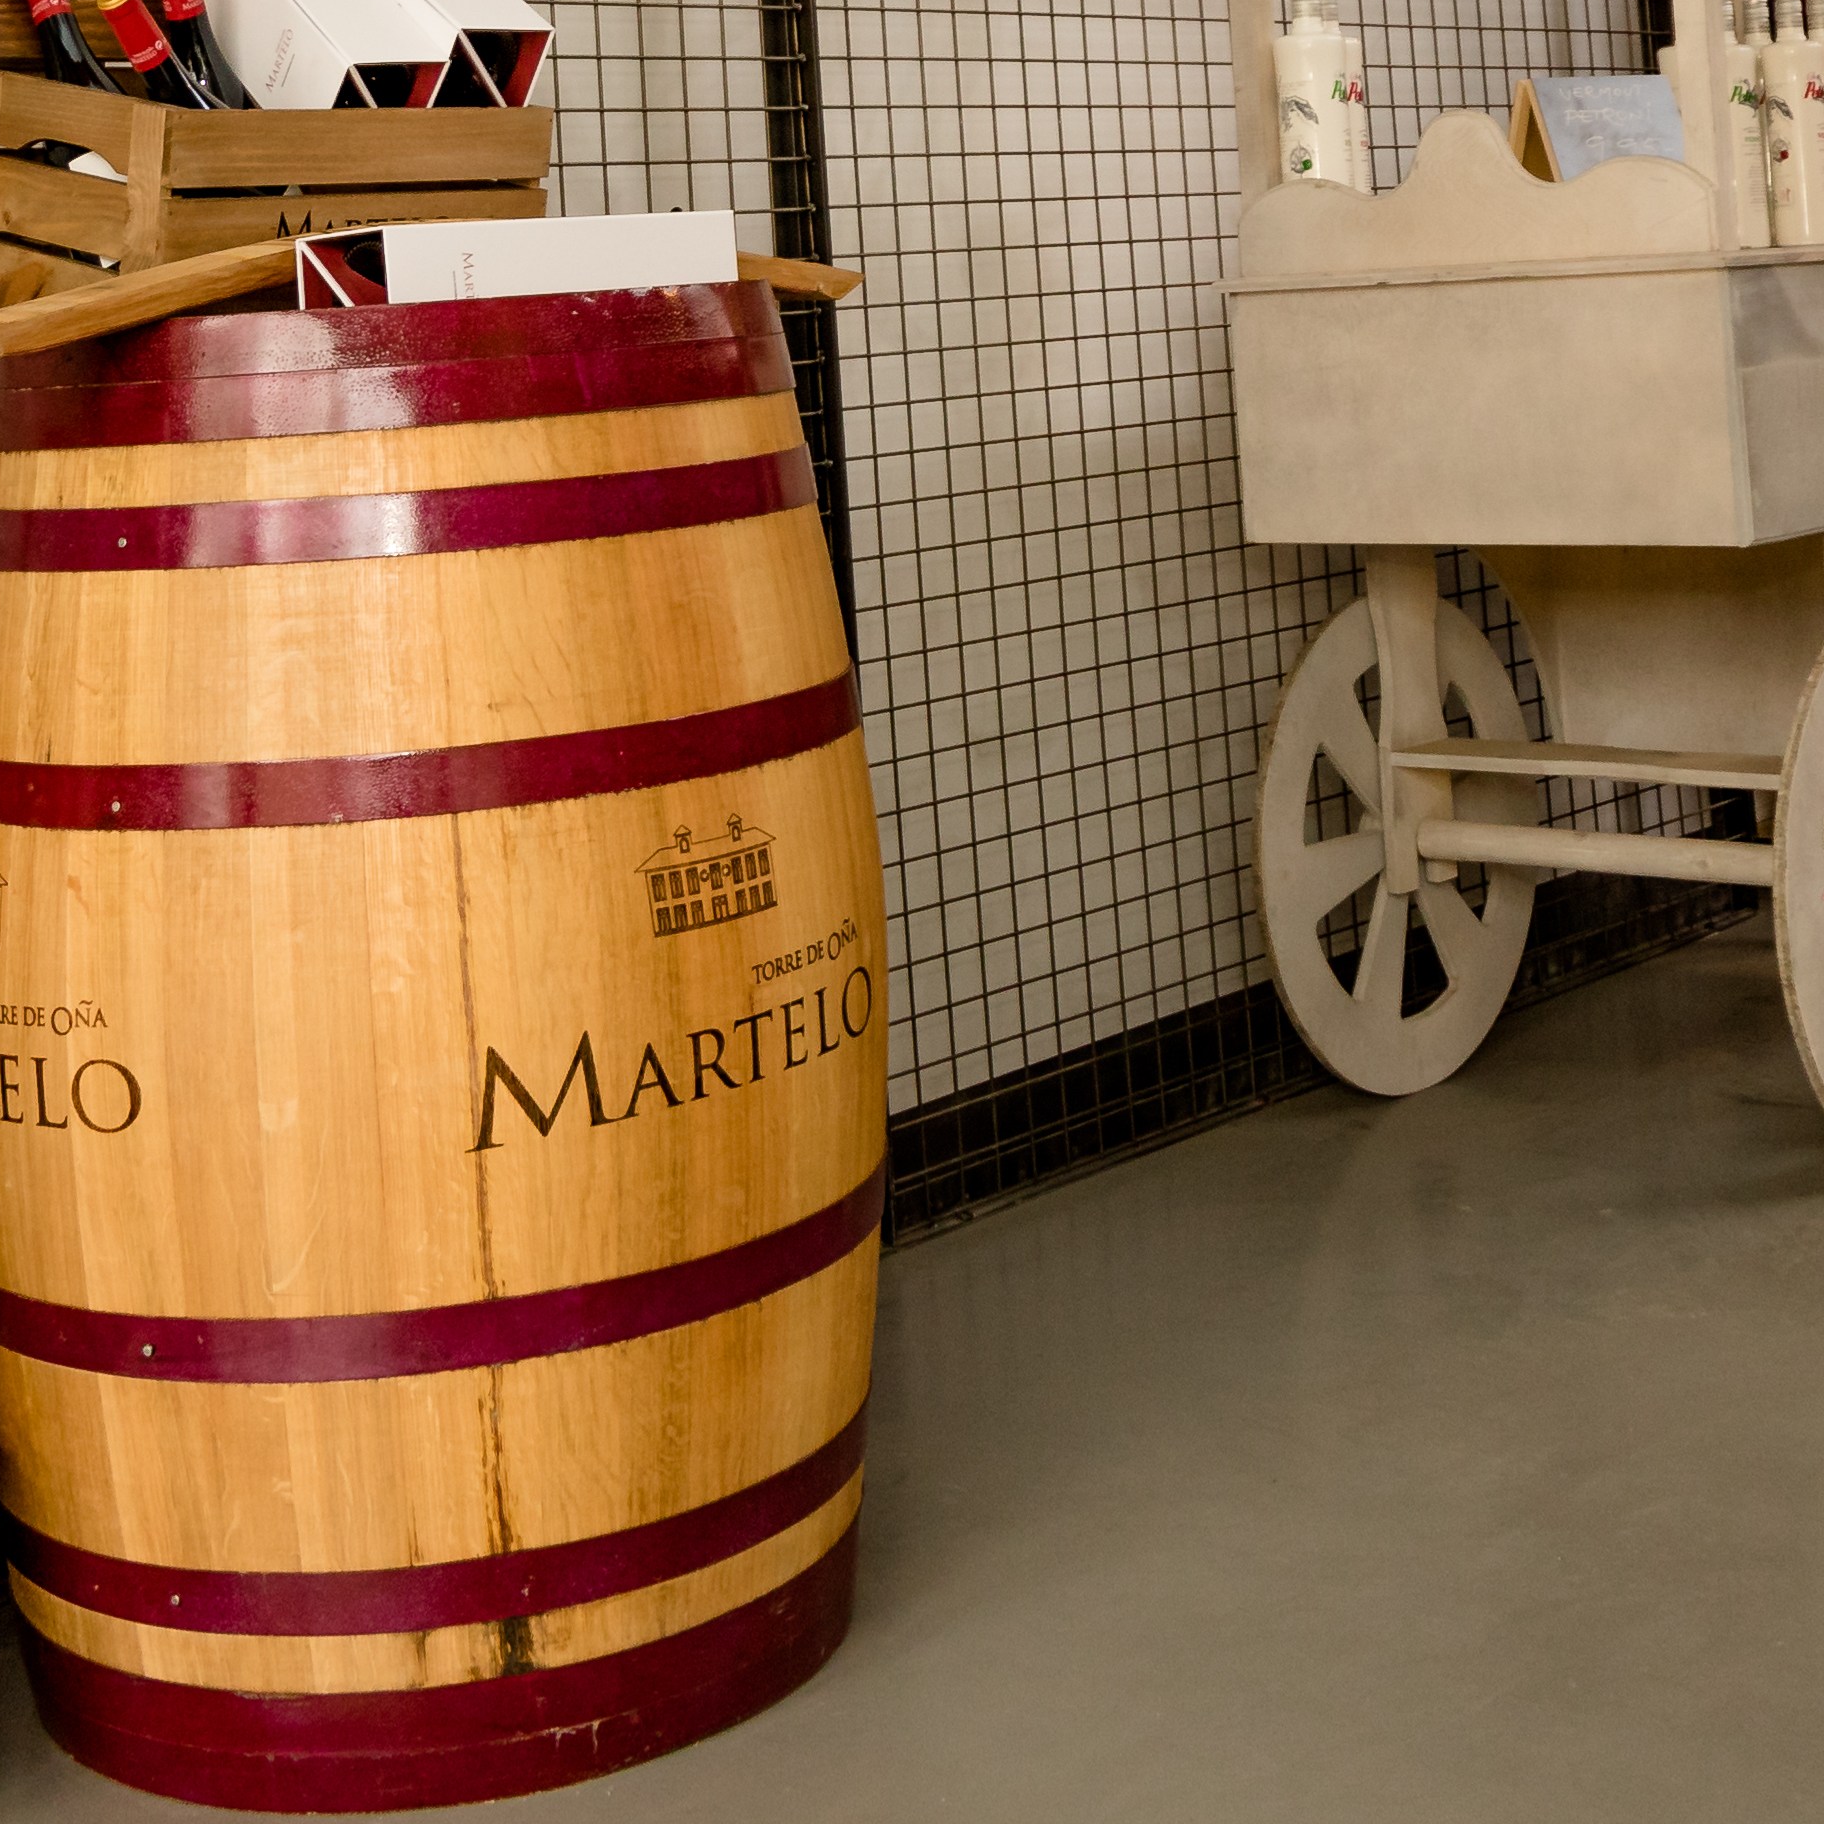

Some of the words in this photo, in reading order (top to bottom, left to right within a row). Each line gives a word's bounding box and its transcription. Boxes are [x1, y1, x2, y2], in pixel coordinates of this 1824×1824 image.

[751, 949, 804, 986] TORRE
[806, 939, 826, 966] DE
[826, 917, 858, 961] OÑA
[23, 1006, 46, 1028] DE
[50, 999, 109, 1036] OÑA
[464, 965, 873, 1154] MARTELO
